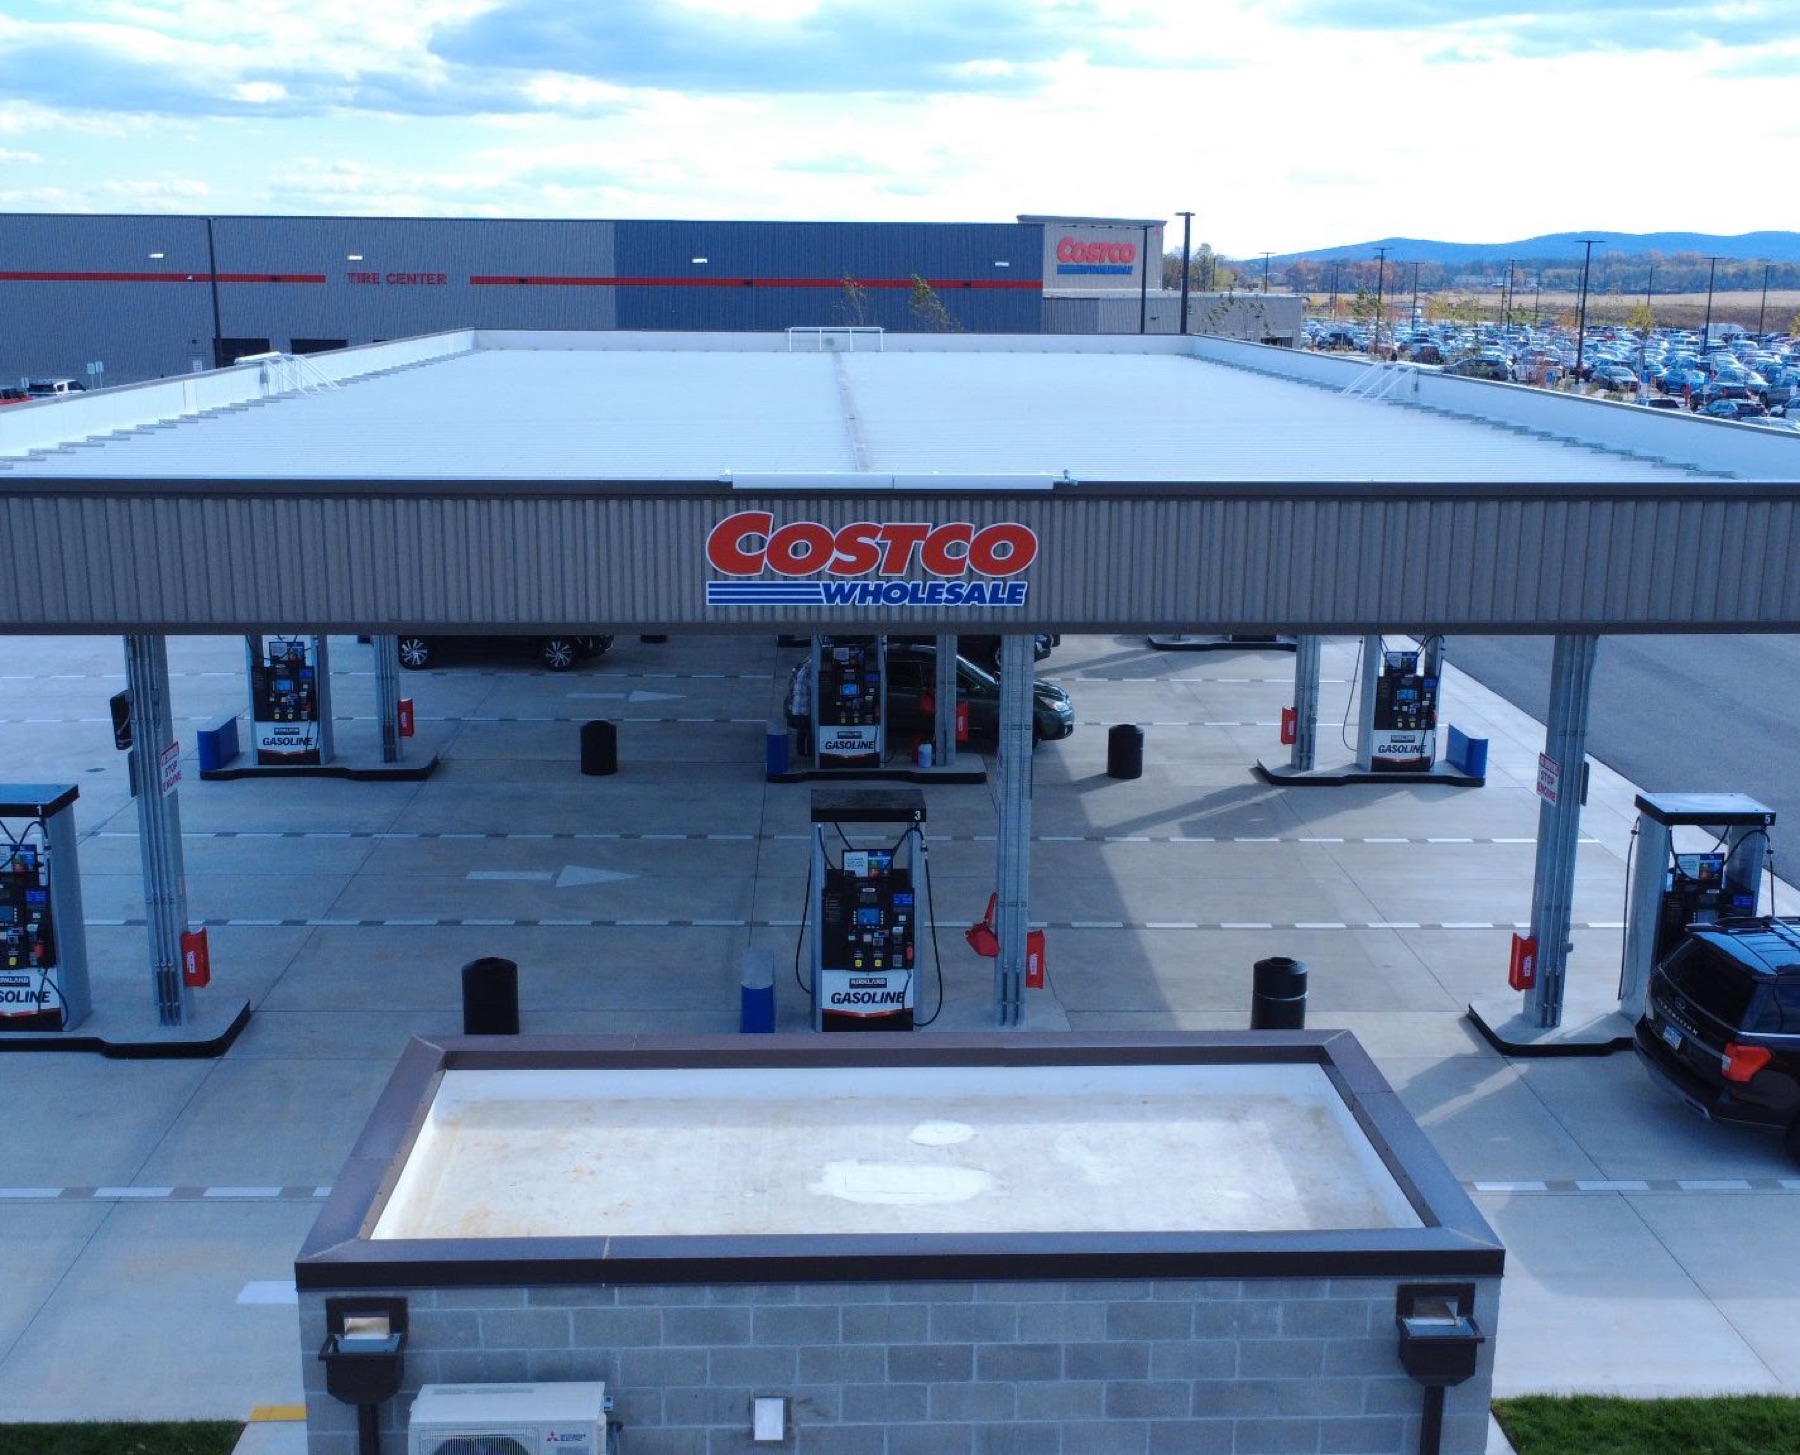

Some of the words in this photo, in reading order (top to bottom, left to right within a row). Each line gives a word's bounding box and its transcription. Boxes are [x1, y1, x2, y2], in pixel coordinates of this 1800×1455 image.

[1056, 235, 1135, 264] COSTCO
[346, 272, 380, 284] TIRE
[386, 272, 447, 285] CENTER
[706, 510, 1038, 577] COSTCO
[819, 581, 1028, 606] WHOLESALE
[262, 737, 313, 746] GASOLINE
[824, 740, 875, 750] GASOLINE
[1377, 744, 1427, 754] GASOLINE
[1540, 769, 1556, 786] STOP
[36, 805, 43, 816] 1
[914, 810, 921, 821] 3
[1764, 814, 1771, 825] 5
[830, 991, 905, 1005] GASOLINE
